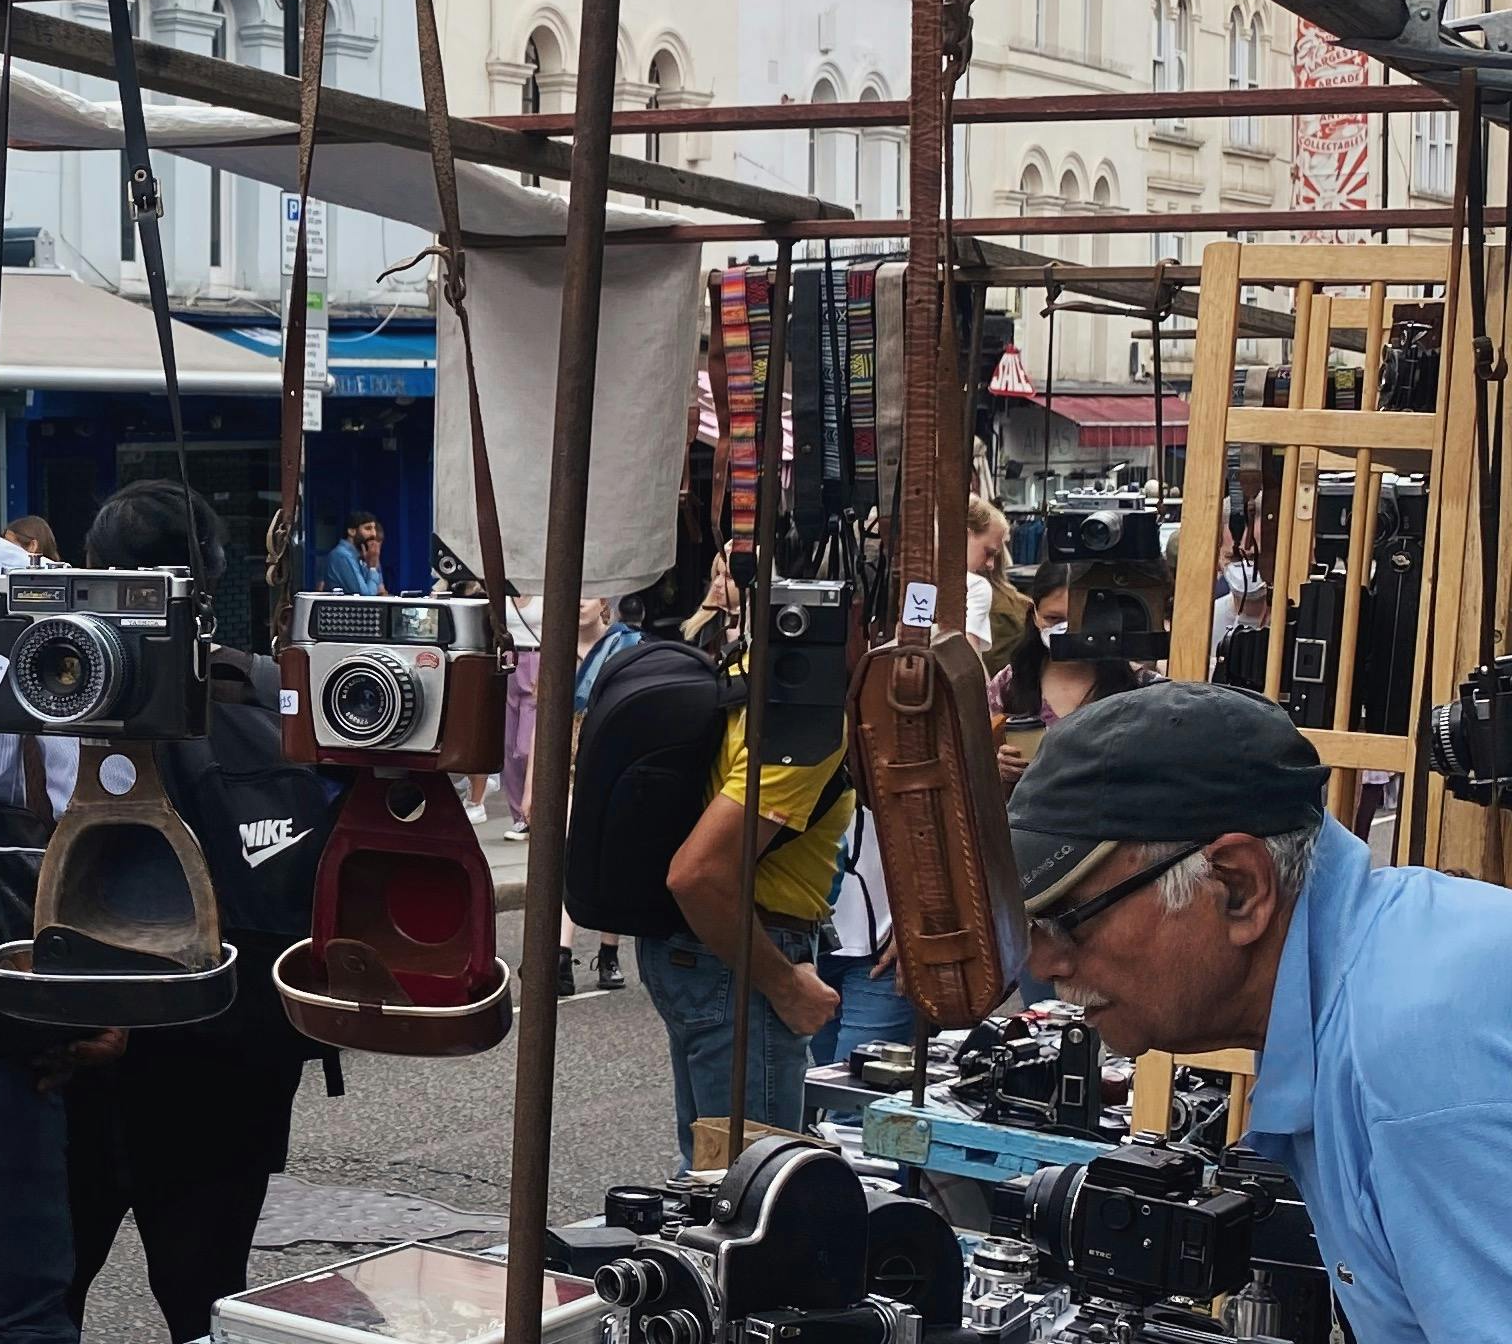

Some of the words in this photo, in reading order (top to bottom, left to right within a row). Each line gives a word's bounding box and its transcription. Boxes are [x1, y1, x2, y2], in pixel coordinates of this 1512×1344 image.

[1319, 71, 1360, 88] ARCADE
[1300, 135, 1364, 152] COLLECTABLES
[990, 353, 1034, 394] SALE
[238, 818, 293, 848] NIKE
